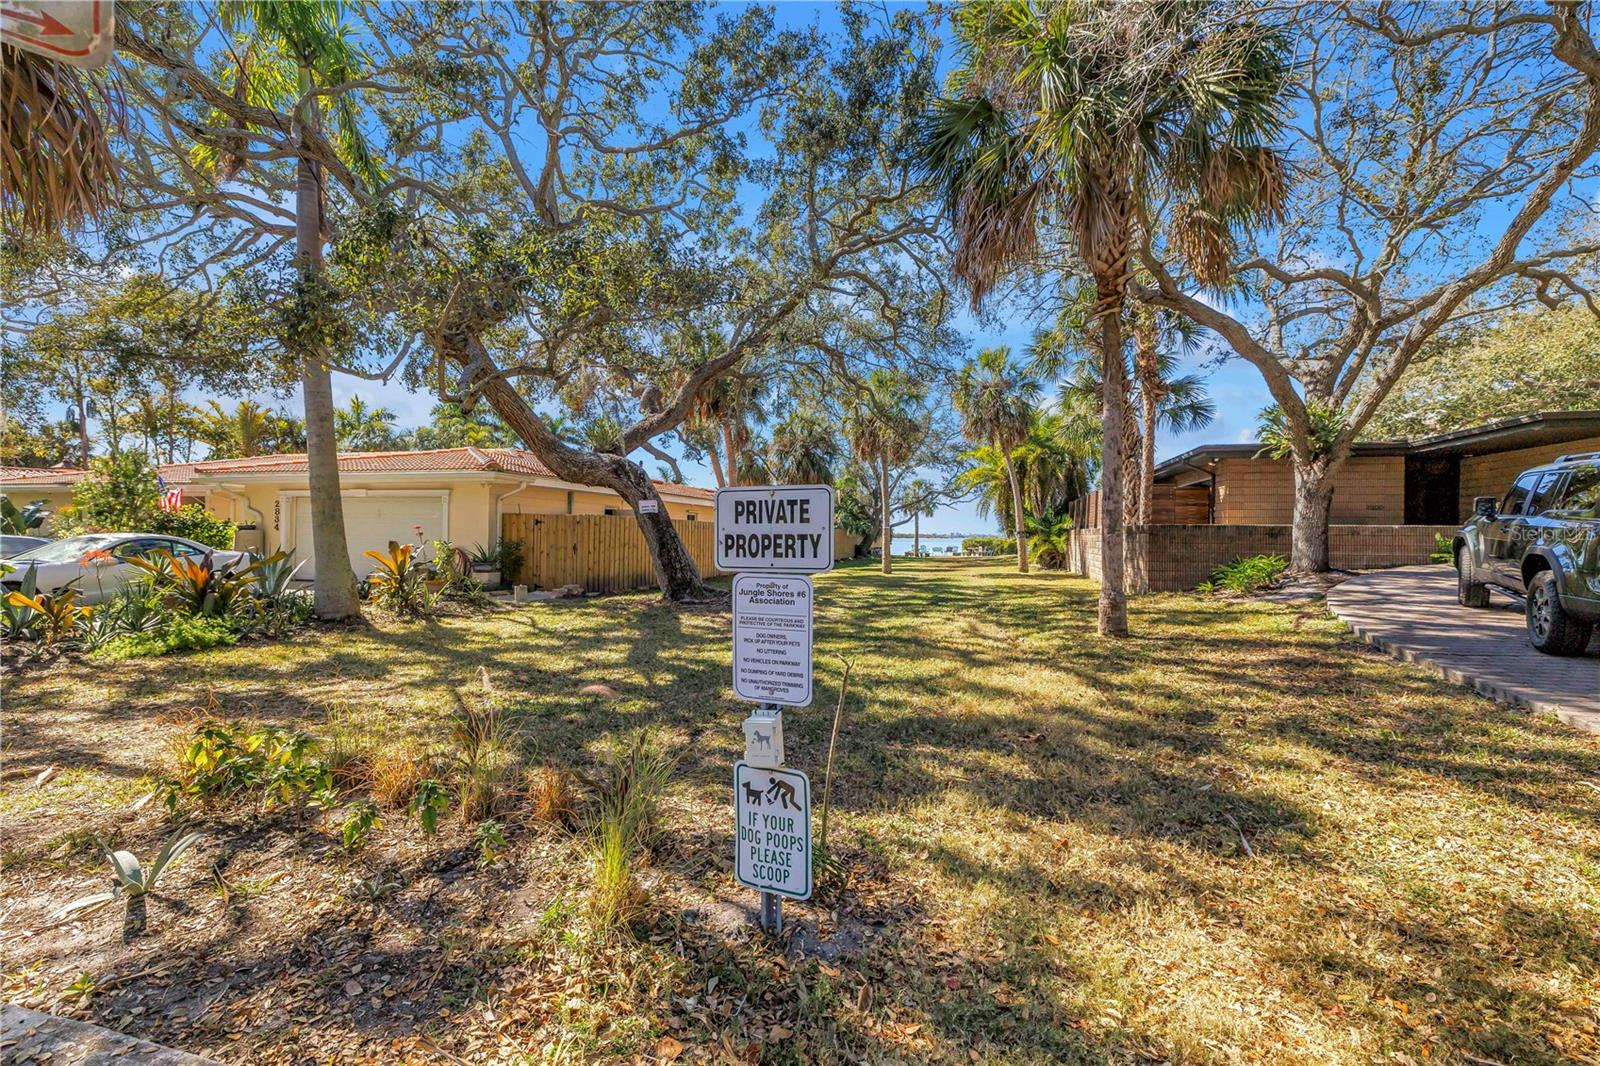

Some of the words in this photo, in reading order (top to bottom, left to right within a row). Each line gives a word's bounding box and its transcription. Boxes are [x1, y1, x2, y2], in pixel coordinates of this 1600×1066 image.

[734, 499, 810, 524] PRIVATE
[724, 533, 822, 559] PROPERTY
[738, 588, 764, 597] Jungle
[767, 589, 795, 597] Shores
[749, 597, 795, 605] Association
[748, 678, 782, 686] UNAUTHORIZED
[748, 811, 758, 827] IF
[762, 814, 794, 833] YOUR
[742, 826, 761, 845] DOG
[766, 832, 804, 852] POOPS
[751, 846, 792, 868] PLEASE
[753, 864, 790, 884] SCOOP
